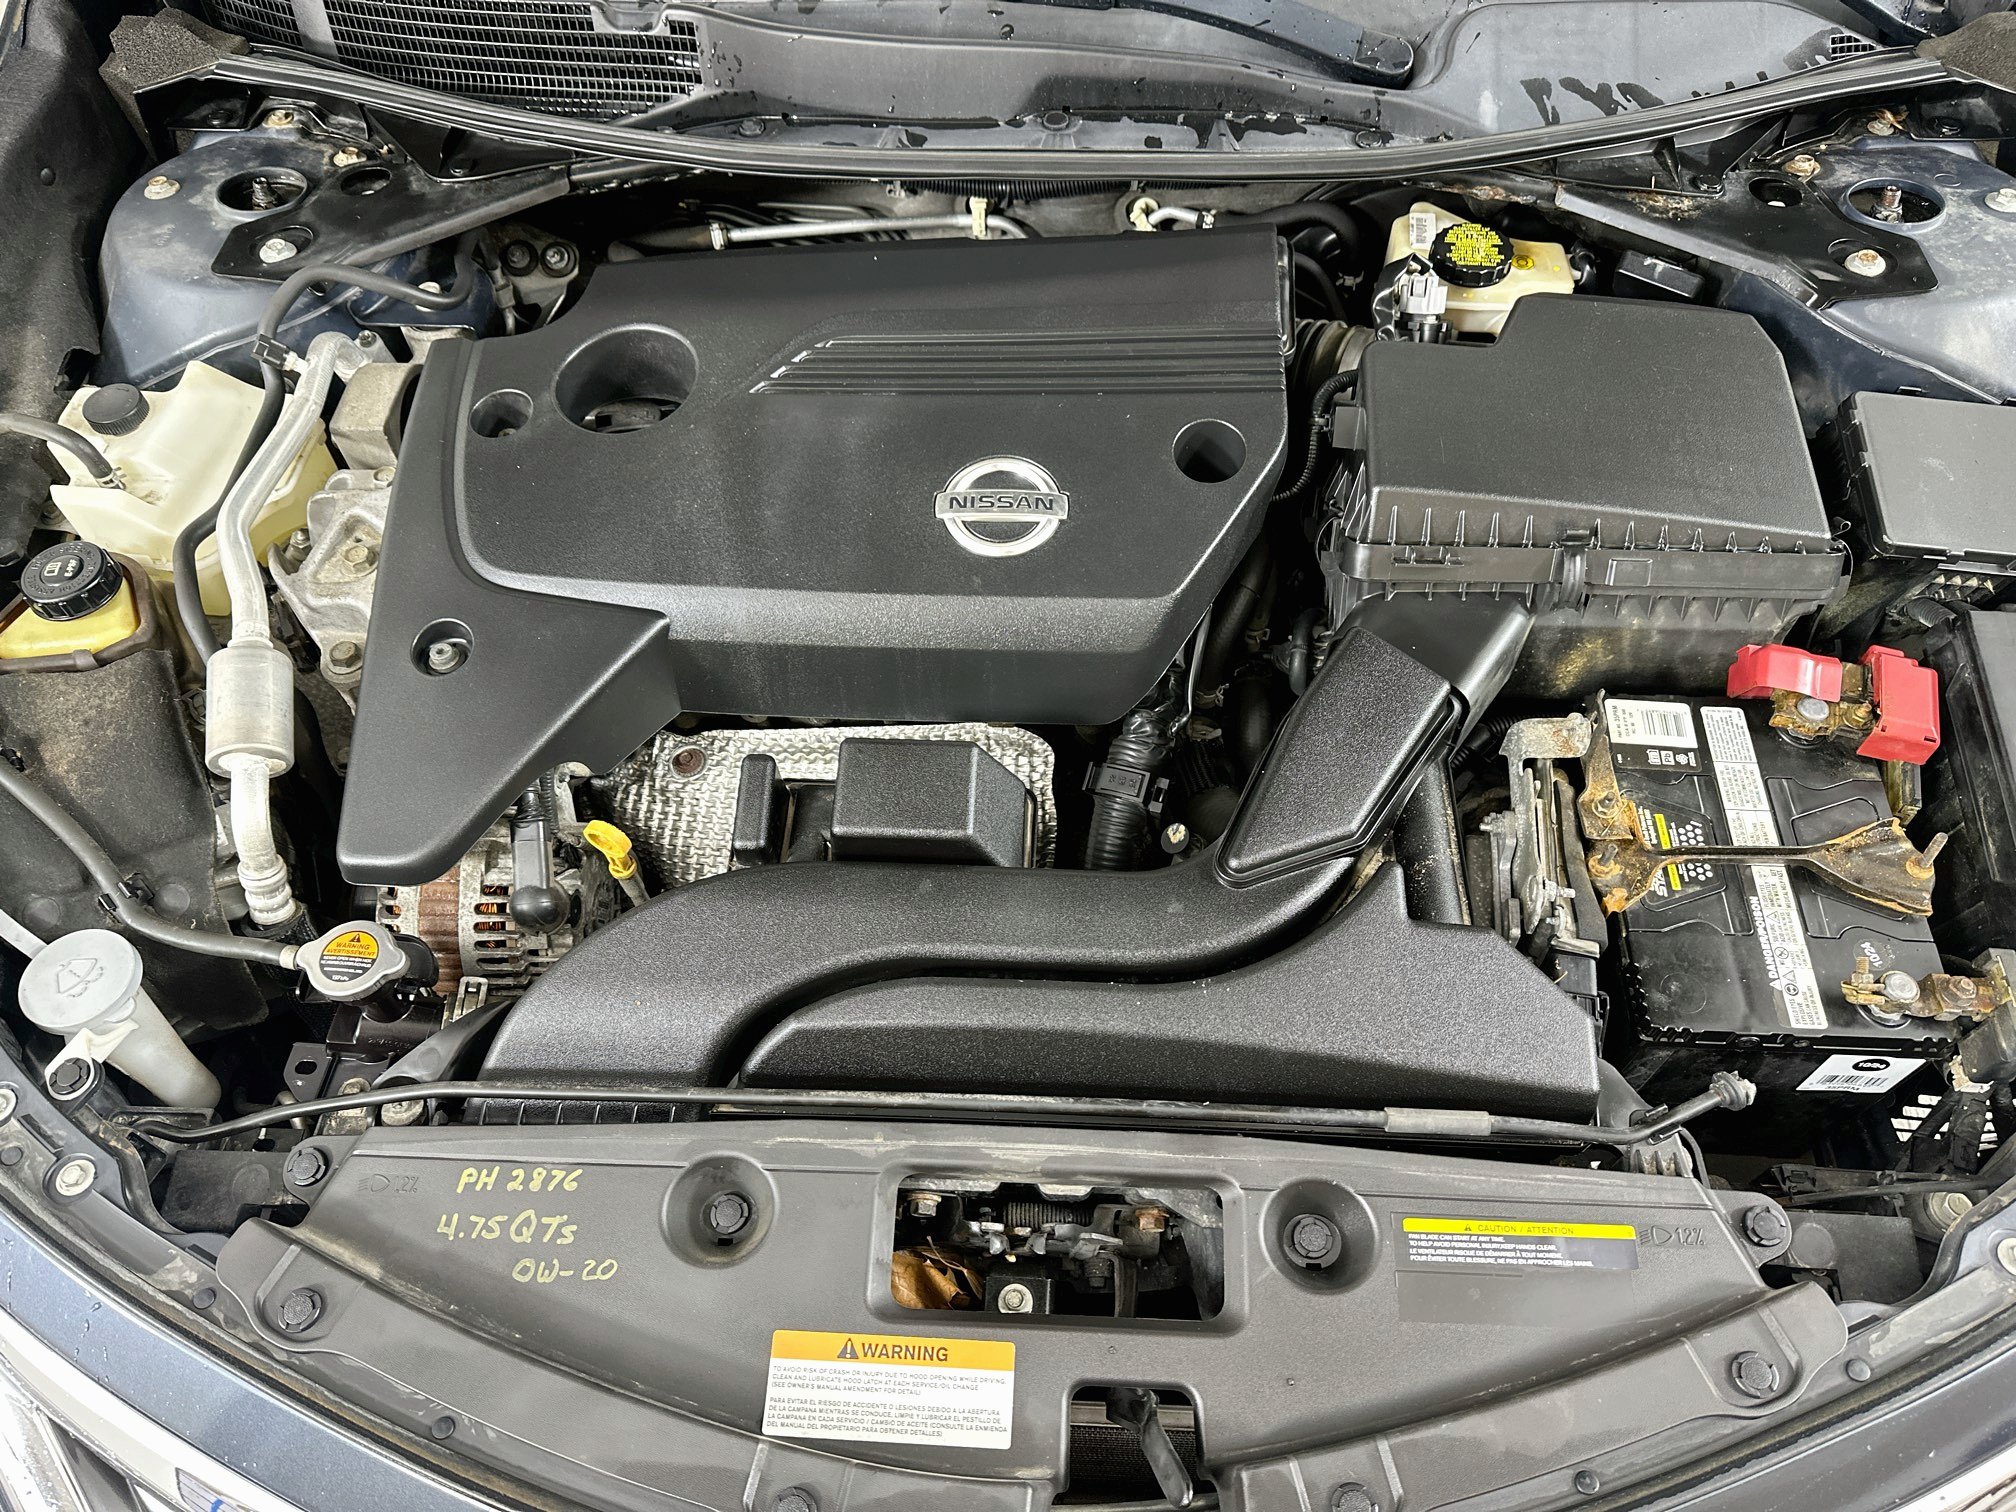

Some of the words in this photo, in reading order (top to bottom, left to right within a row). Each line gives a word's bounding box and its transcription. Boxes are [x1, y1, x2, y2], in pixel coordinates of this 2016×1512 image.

[950, 495, 1054, 511] NISSAN
[1663, 752, 1672, 763] Pb
[336, 942, 370, 950] WARNING
[1749, 896, 1779, 979] DANGER/POISON
[456, 1165, 500, 1194] PH
[506, 1167, 583, 1192] 2876
[437, 1212, 509, 1240] 4.75
[1477, 1224, 1516, 1232] CAUTION
[1526, 1225, 1573, 1234] ATTENTION
[862, 1342, 949, 1362] WARNING
[772, 1372, 792, 1380] CLEAN
[952, 1383, 978, 1391] CHANGE
[816, 1383, 841, 1391] MANUAL
[842, 1385, 882, 1393] AMENDMENT
[787, 1405, 817, 1413] CAMPANA
[818, 1407, 849, 1415] MIENTRAS
[894, 1411, 913, 1419] LIMPIE
[921, 1413, 951, 1421] LUBRICAR
[962, 1416, 991, 1424] PESTILLO
[852, 1401, 887, 1409] ACCIDENTE
[895, 1404, 926, 1412] LESIONES
[927, 1405, 951, 1413] DEBIDO
[967, 1408, 1000, 1416] ABERTURA
[776, 1412, 806, 1420] CAMPANA
[835, 1416, 865, 1424] SERVICIO
[870, 1418, 895, 1426] CAMBIO
[906, 1420, 928, 1428] ACEITE
[974, 1424, 1007, 1433] ENMIENDA
[819, 1423, 860, 1432] PROPIETARIO
[879, 1427, 908, 1435] OBTENER
